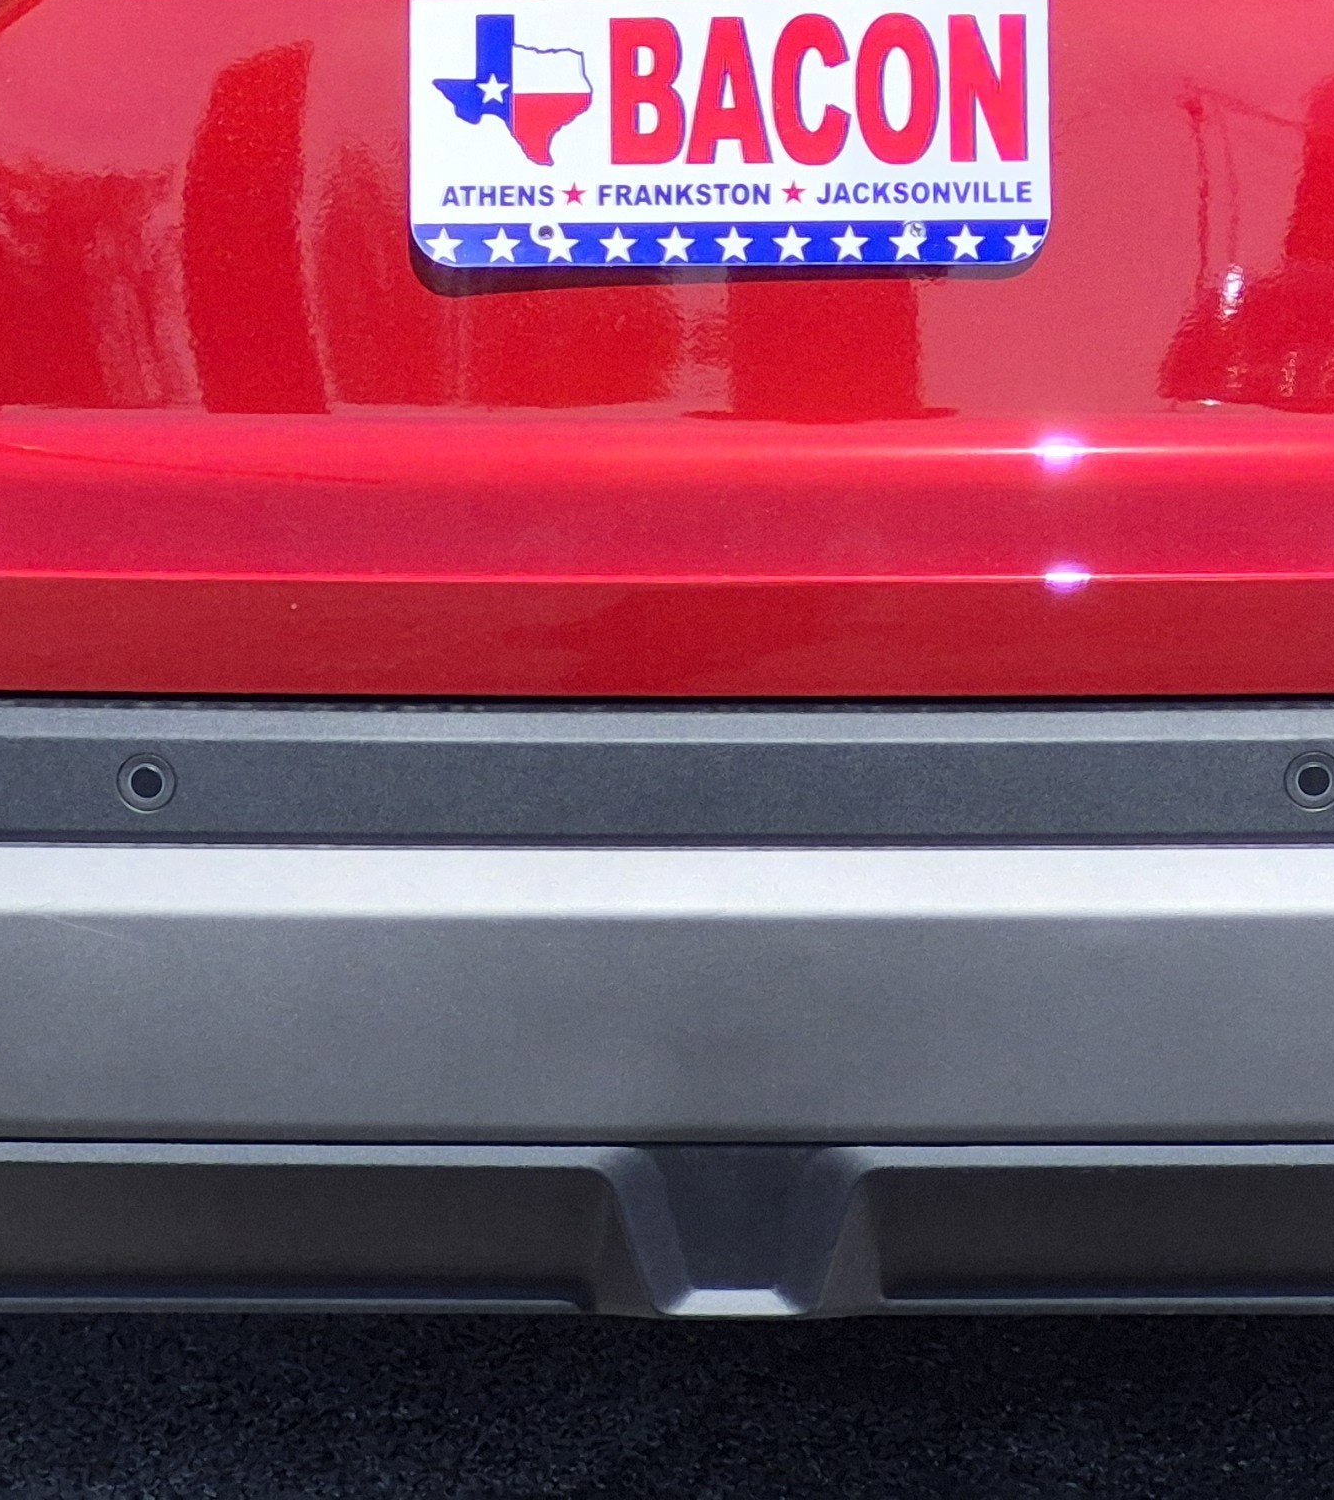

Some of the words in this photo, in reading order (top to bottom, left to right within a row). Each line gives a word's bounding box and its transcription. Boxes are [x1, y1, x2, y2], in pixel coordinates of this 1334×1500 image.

[608, 11, 1030, 166] BACON
[442, 184, 556, 207] ATHENS
[598, 183, 772, 206] FRANKSTON
[816, 181, 1033, 205] JACKSONVILLE
